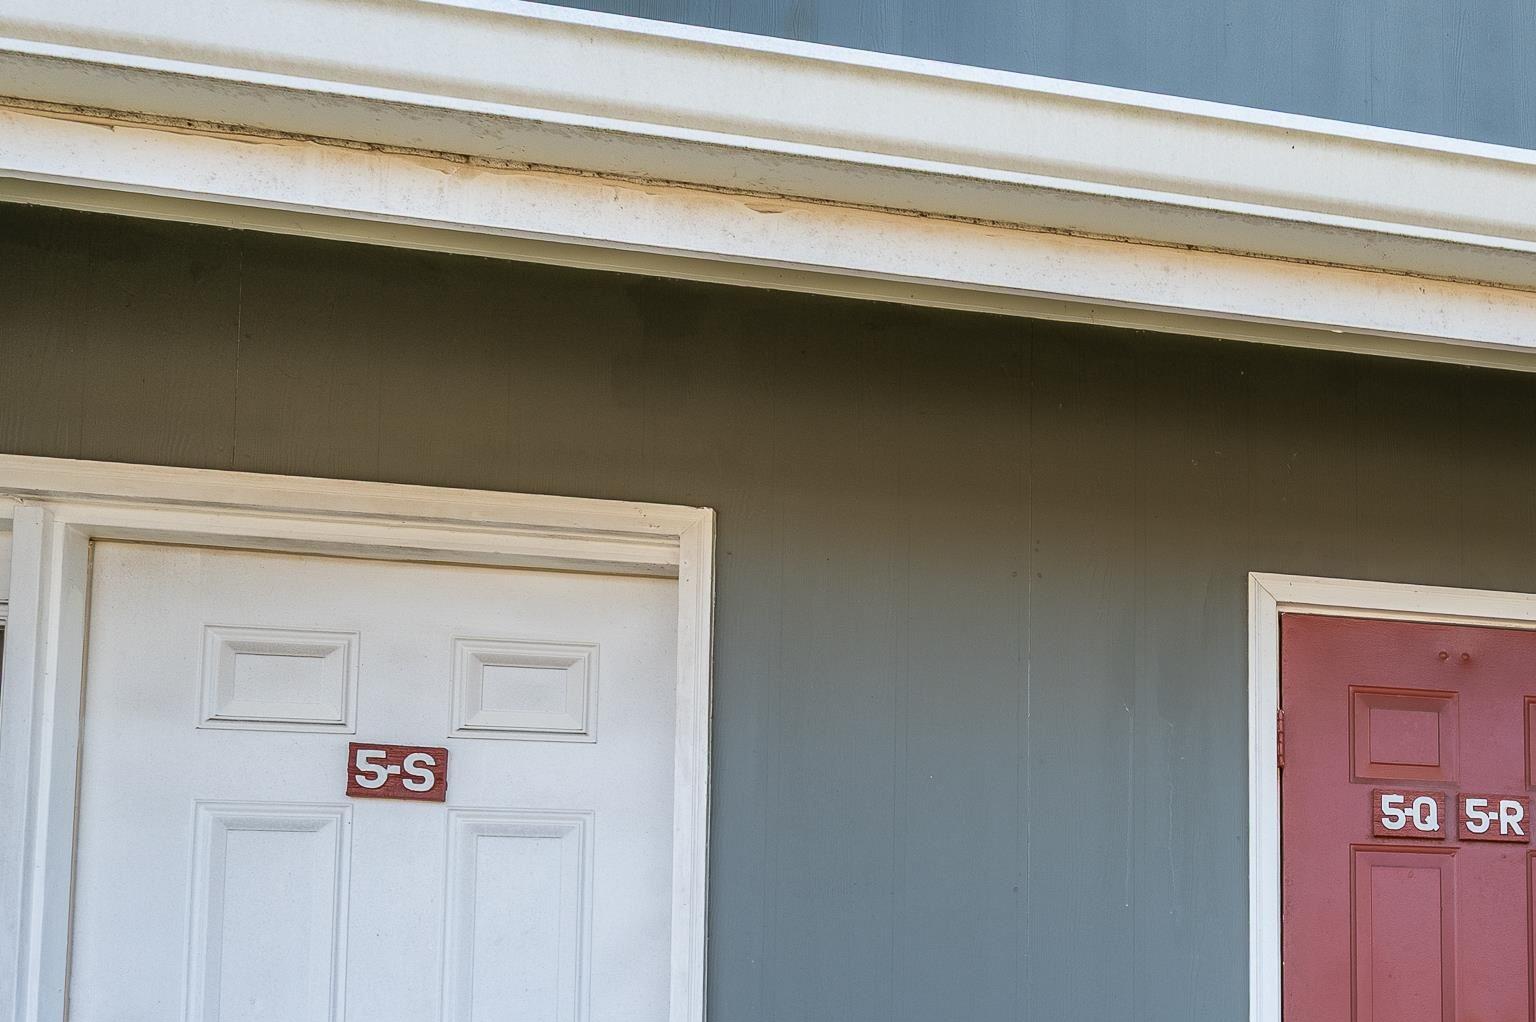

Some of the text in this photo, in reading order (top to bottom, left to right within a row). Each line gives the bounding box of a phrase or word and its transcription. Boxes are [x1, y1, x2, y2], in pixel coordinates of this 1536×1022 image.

[354, 749, 436, 792] 5-S
[1380, 793, 1440, 832] 5-Q
[1464, 797, 1525, 836] 5-R
